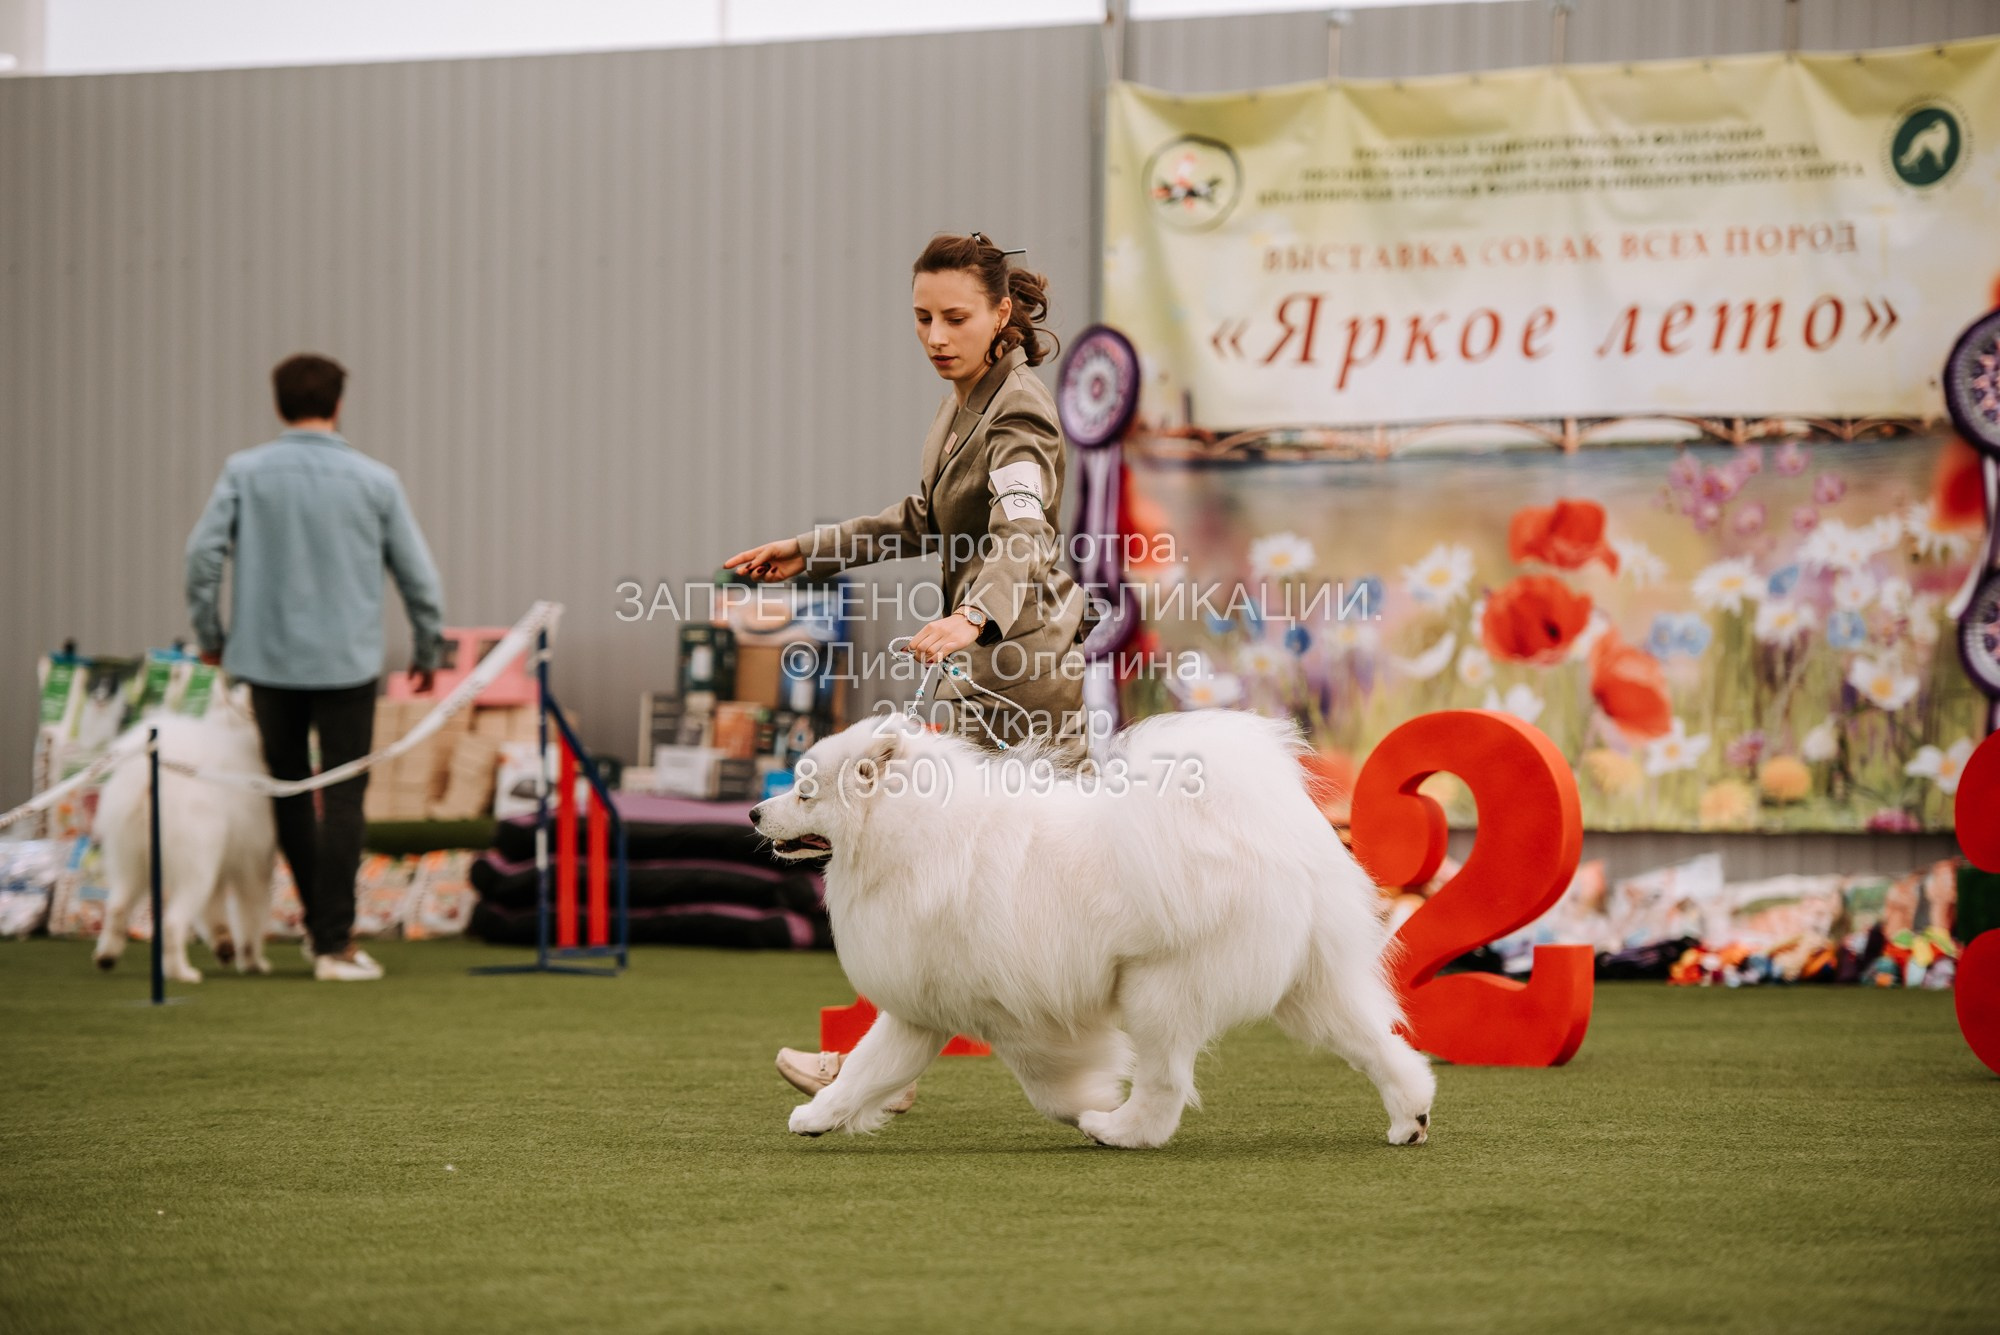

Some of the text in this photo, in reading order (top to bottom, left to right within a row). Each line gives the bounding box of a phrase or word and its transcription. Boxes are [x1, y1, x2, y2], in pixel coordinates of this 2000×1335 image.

[1262, 219, 1858, 273] ВЫСТАВКА СОБАК ВСЕХ ПОРОД
[1210, 291, 1901, 391] «Яркое лето»
[1350, 709, 1594, 1067] 2
